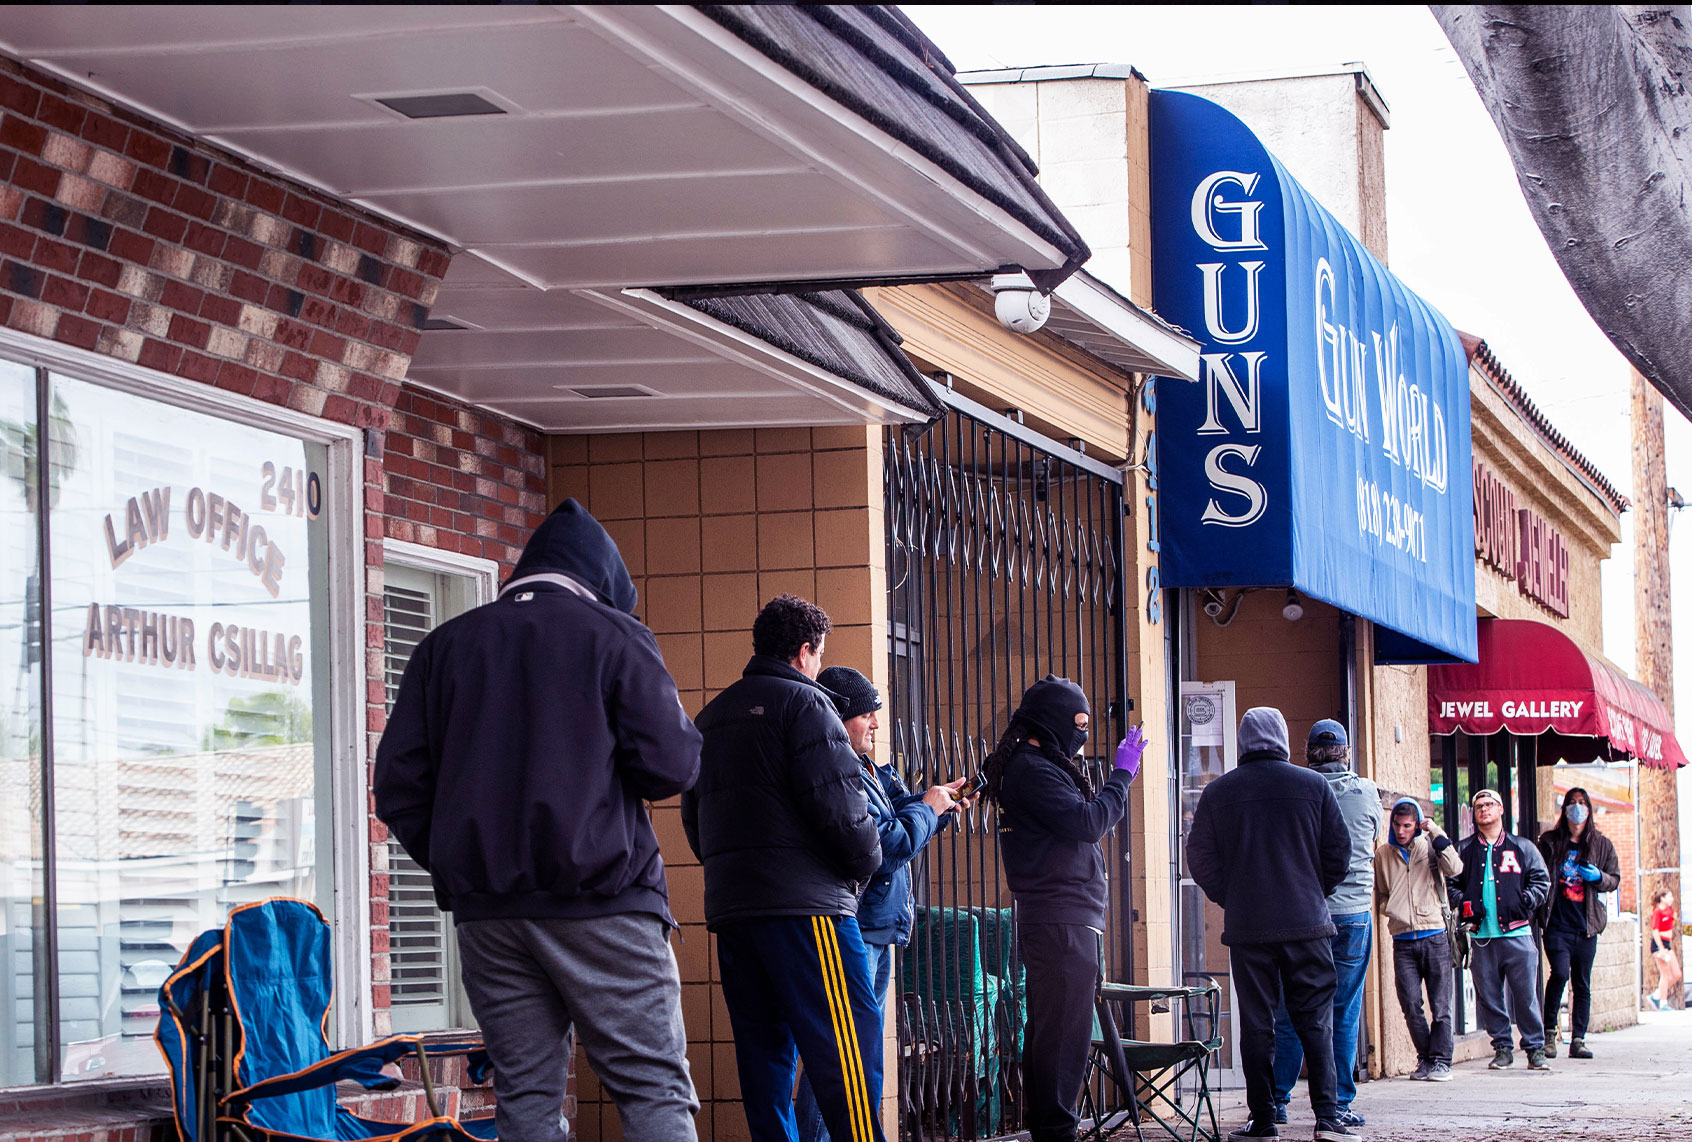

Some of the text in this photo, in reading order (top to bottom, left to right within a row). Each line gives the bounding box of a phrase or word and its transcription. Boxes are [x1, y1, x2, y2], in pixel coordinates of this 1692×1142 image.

[1190, 170, 1269, 528] GUNS
[1314, 256, 1448, 495] GUN WORLD
[261, 460, 322, 521] 2410
[1356, 470, 1383, 547] (818)
[104, 486, 287, 599] LAW OFFICE
[84, 602, 304, 686] ARTHUR CSILLAG
[1439, 700, 1584, 719] JEWEL GALLERY
[1499, 850, 1522, 874] A
[1462, 900, 1475, 918] A
